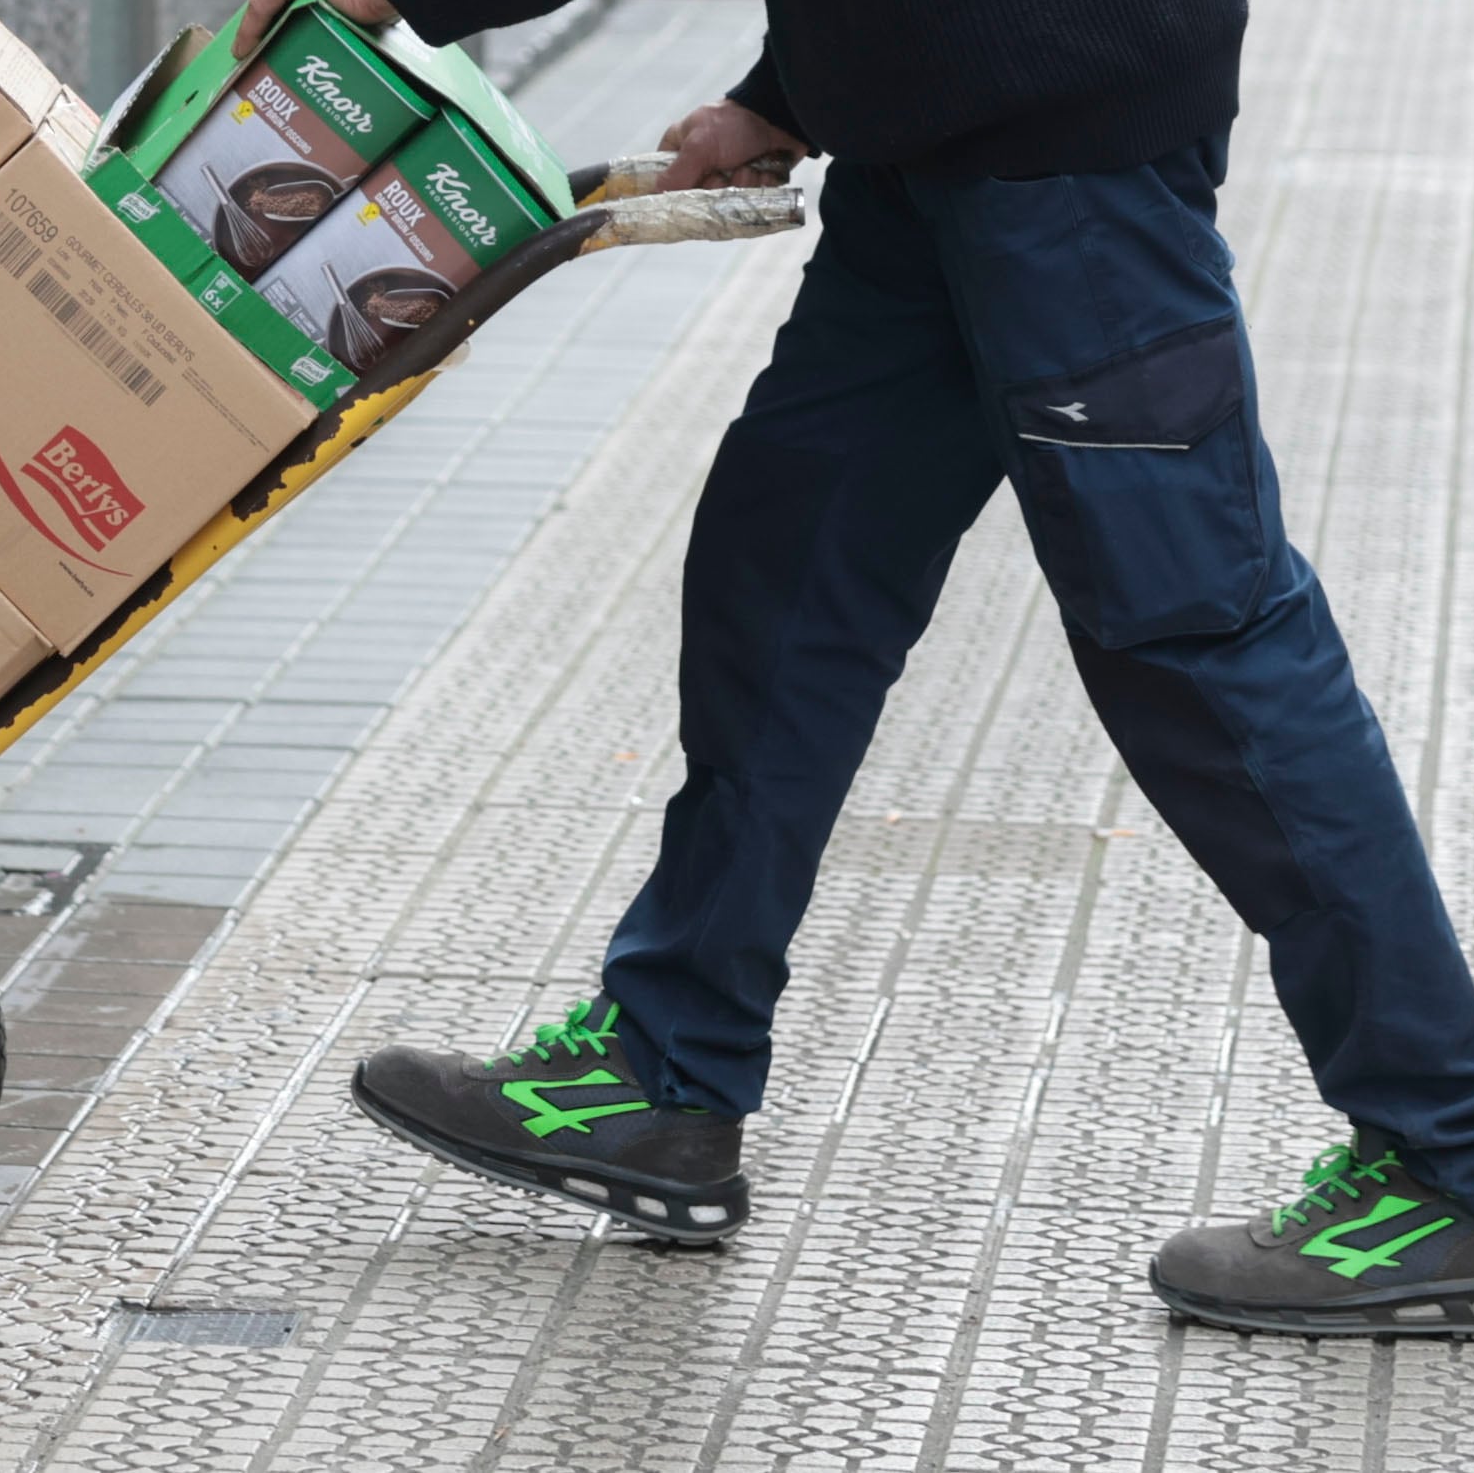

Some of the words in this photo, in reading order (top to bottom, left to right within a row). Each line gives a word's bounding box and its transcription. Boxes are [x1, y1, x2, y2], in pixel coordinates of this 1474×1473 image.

[255, 76, 300, 122] ROUX
[296, 55, 373, 133] Knorr
[296, 78, 356, 136] PROFESSIONAL
[3, 187, 59, 243] 107659
[382, 180, 425, 227] ROUX
[424, 184, 479, 248] PROFESSIONAL
[426, 163, 497, 245] Knorr
[65, 235, 106, 276] GOURMET
[103, 272, 145, 314] CEREALES
[163, 328, 196, 362] BERLYS
[204, 289, 224, 310] 6x
[42, 438, 129, 526] Berlys
